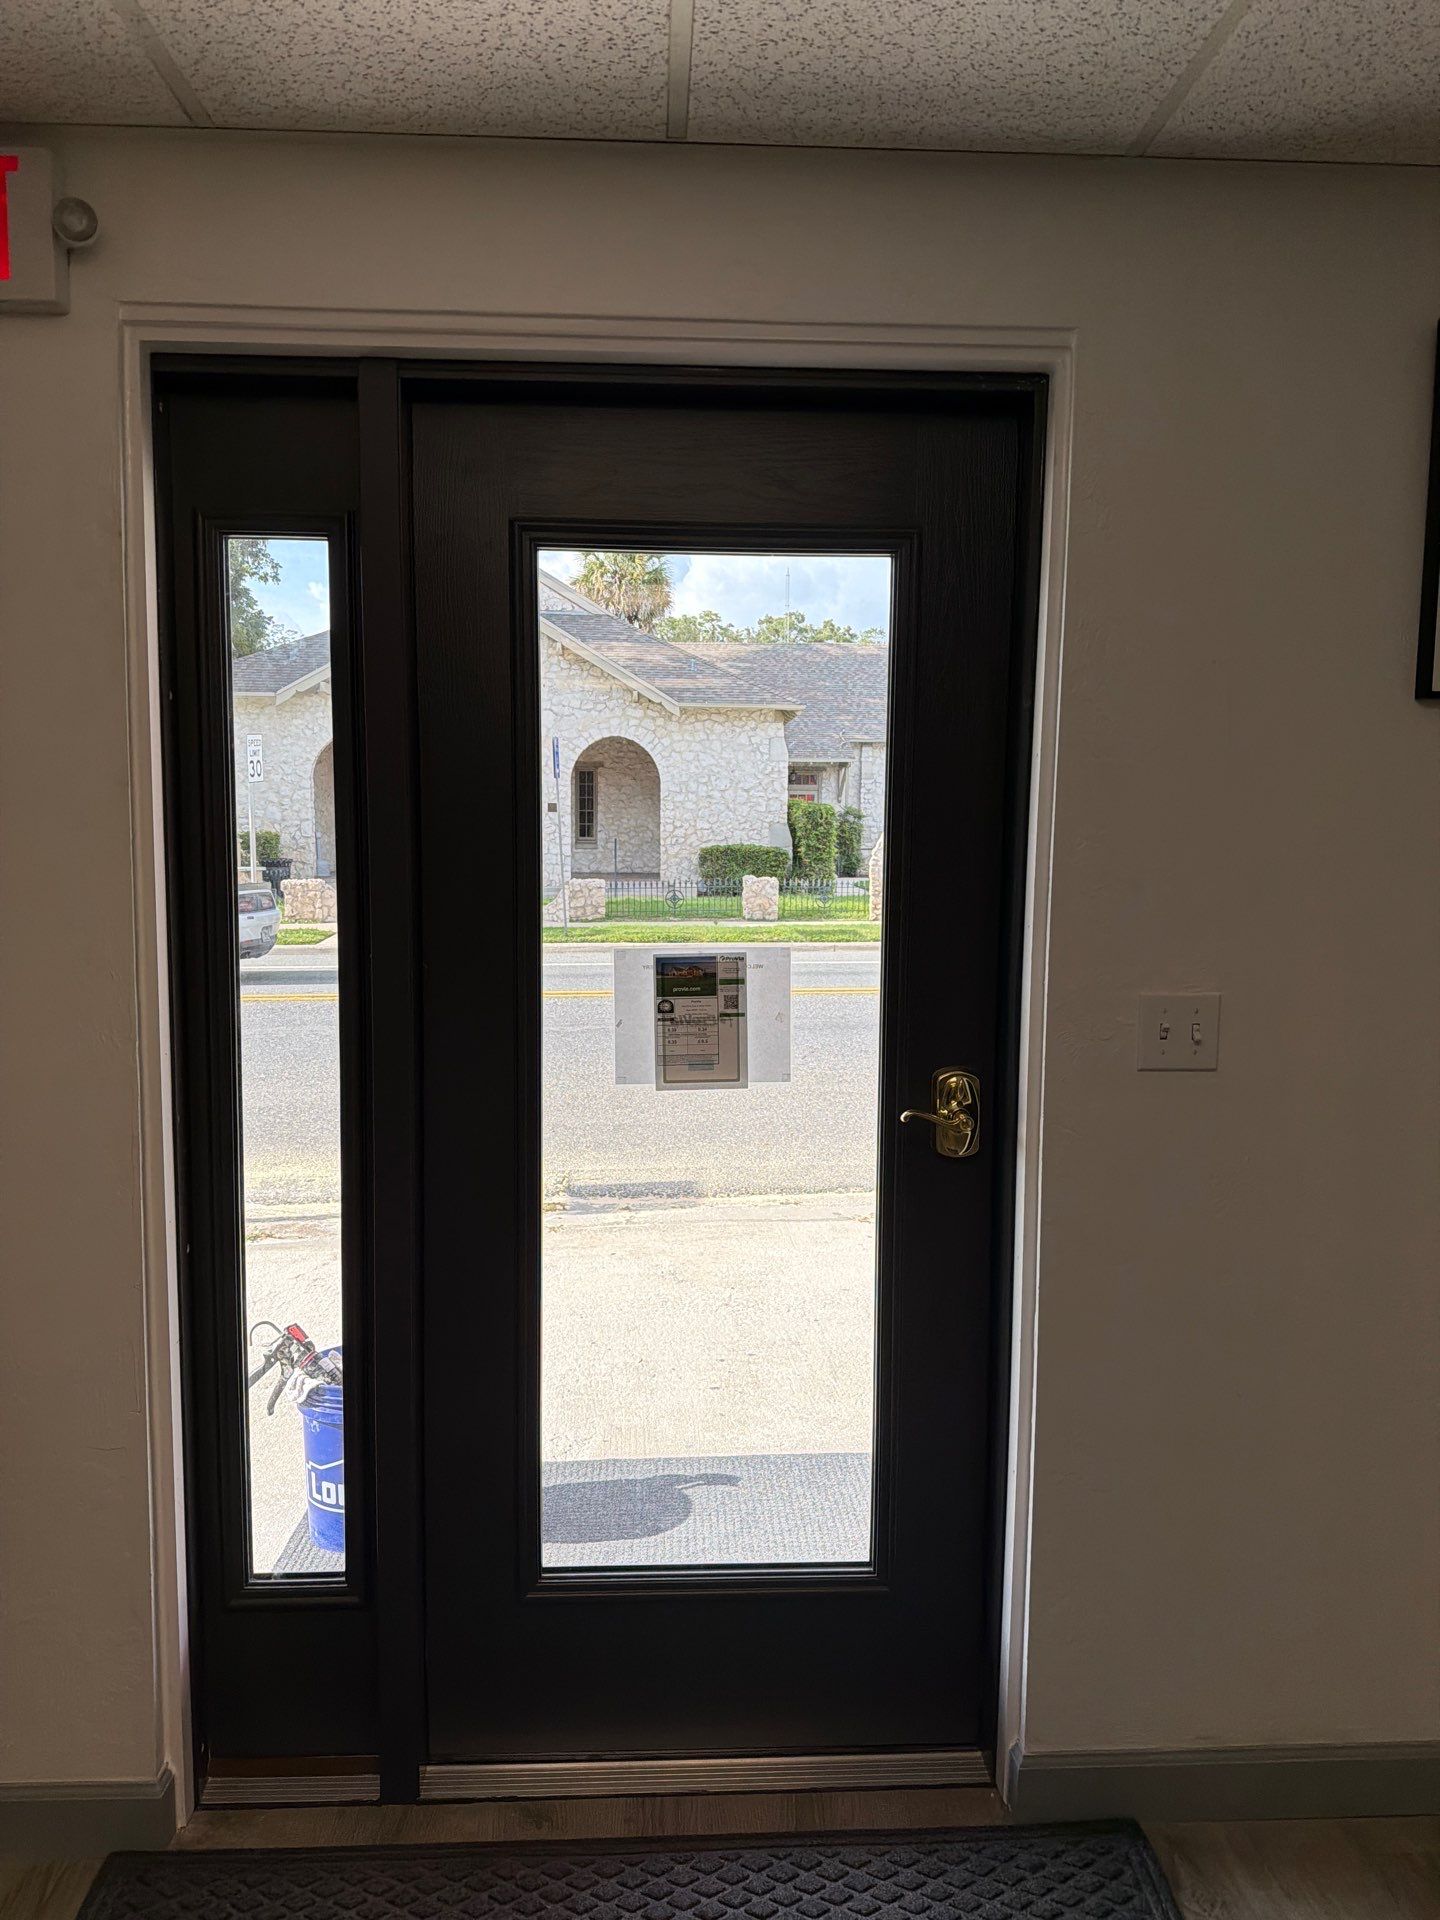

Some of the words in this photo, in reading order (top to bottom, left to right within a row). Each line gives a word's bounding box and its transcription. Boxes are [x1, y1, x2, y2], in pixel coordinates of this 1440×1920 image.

[248, 739, 262, 747] SPEED
[249, 749, 260, 757] LIMIT
[249, 760, 262, 778] 30
